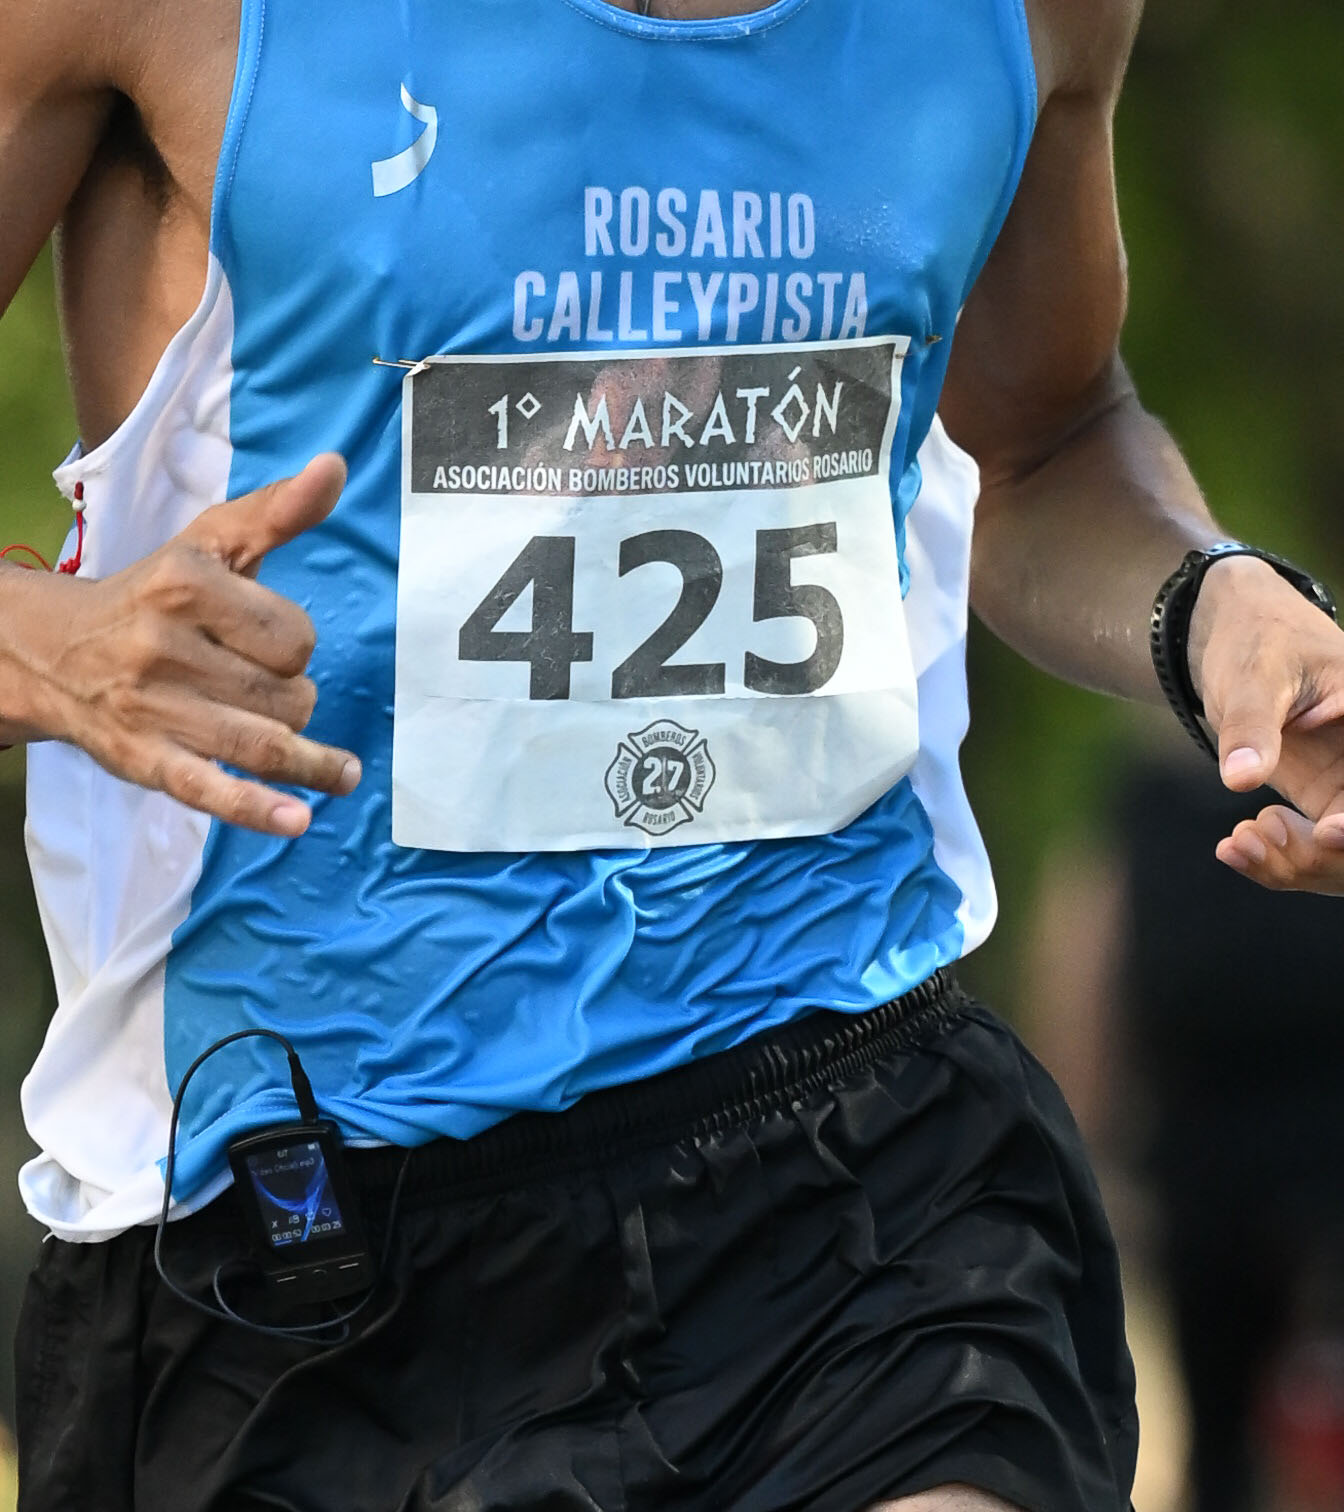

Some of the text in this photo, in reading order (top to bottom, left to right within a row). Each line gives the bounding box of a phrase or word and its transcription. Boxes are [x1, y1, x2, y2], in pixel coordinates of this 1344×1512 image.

[584, 186, 816, 259] ROSARIO
[512, 270, 868, 342] CALLEYPISTA
[562, 365, 844, 452] MARATÓN
[432, 448, 874, 492] ASOCIACIÓN BOMBEROS VOLUNTARIOS ROSARIO
[458, 521, 845, 701] 425
[641, 730, 687, 748] BOMBEROS
[642, 756, 684, 795] 27
[642, 810, 676, 826] ROSARIO
